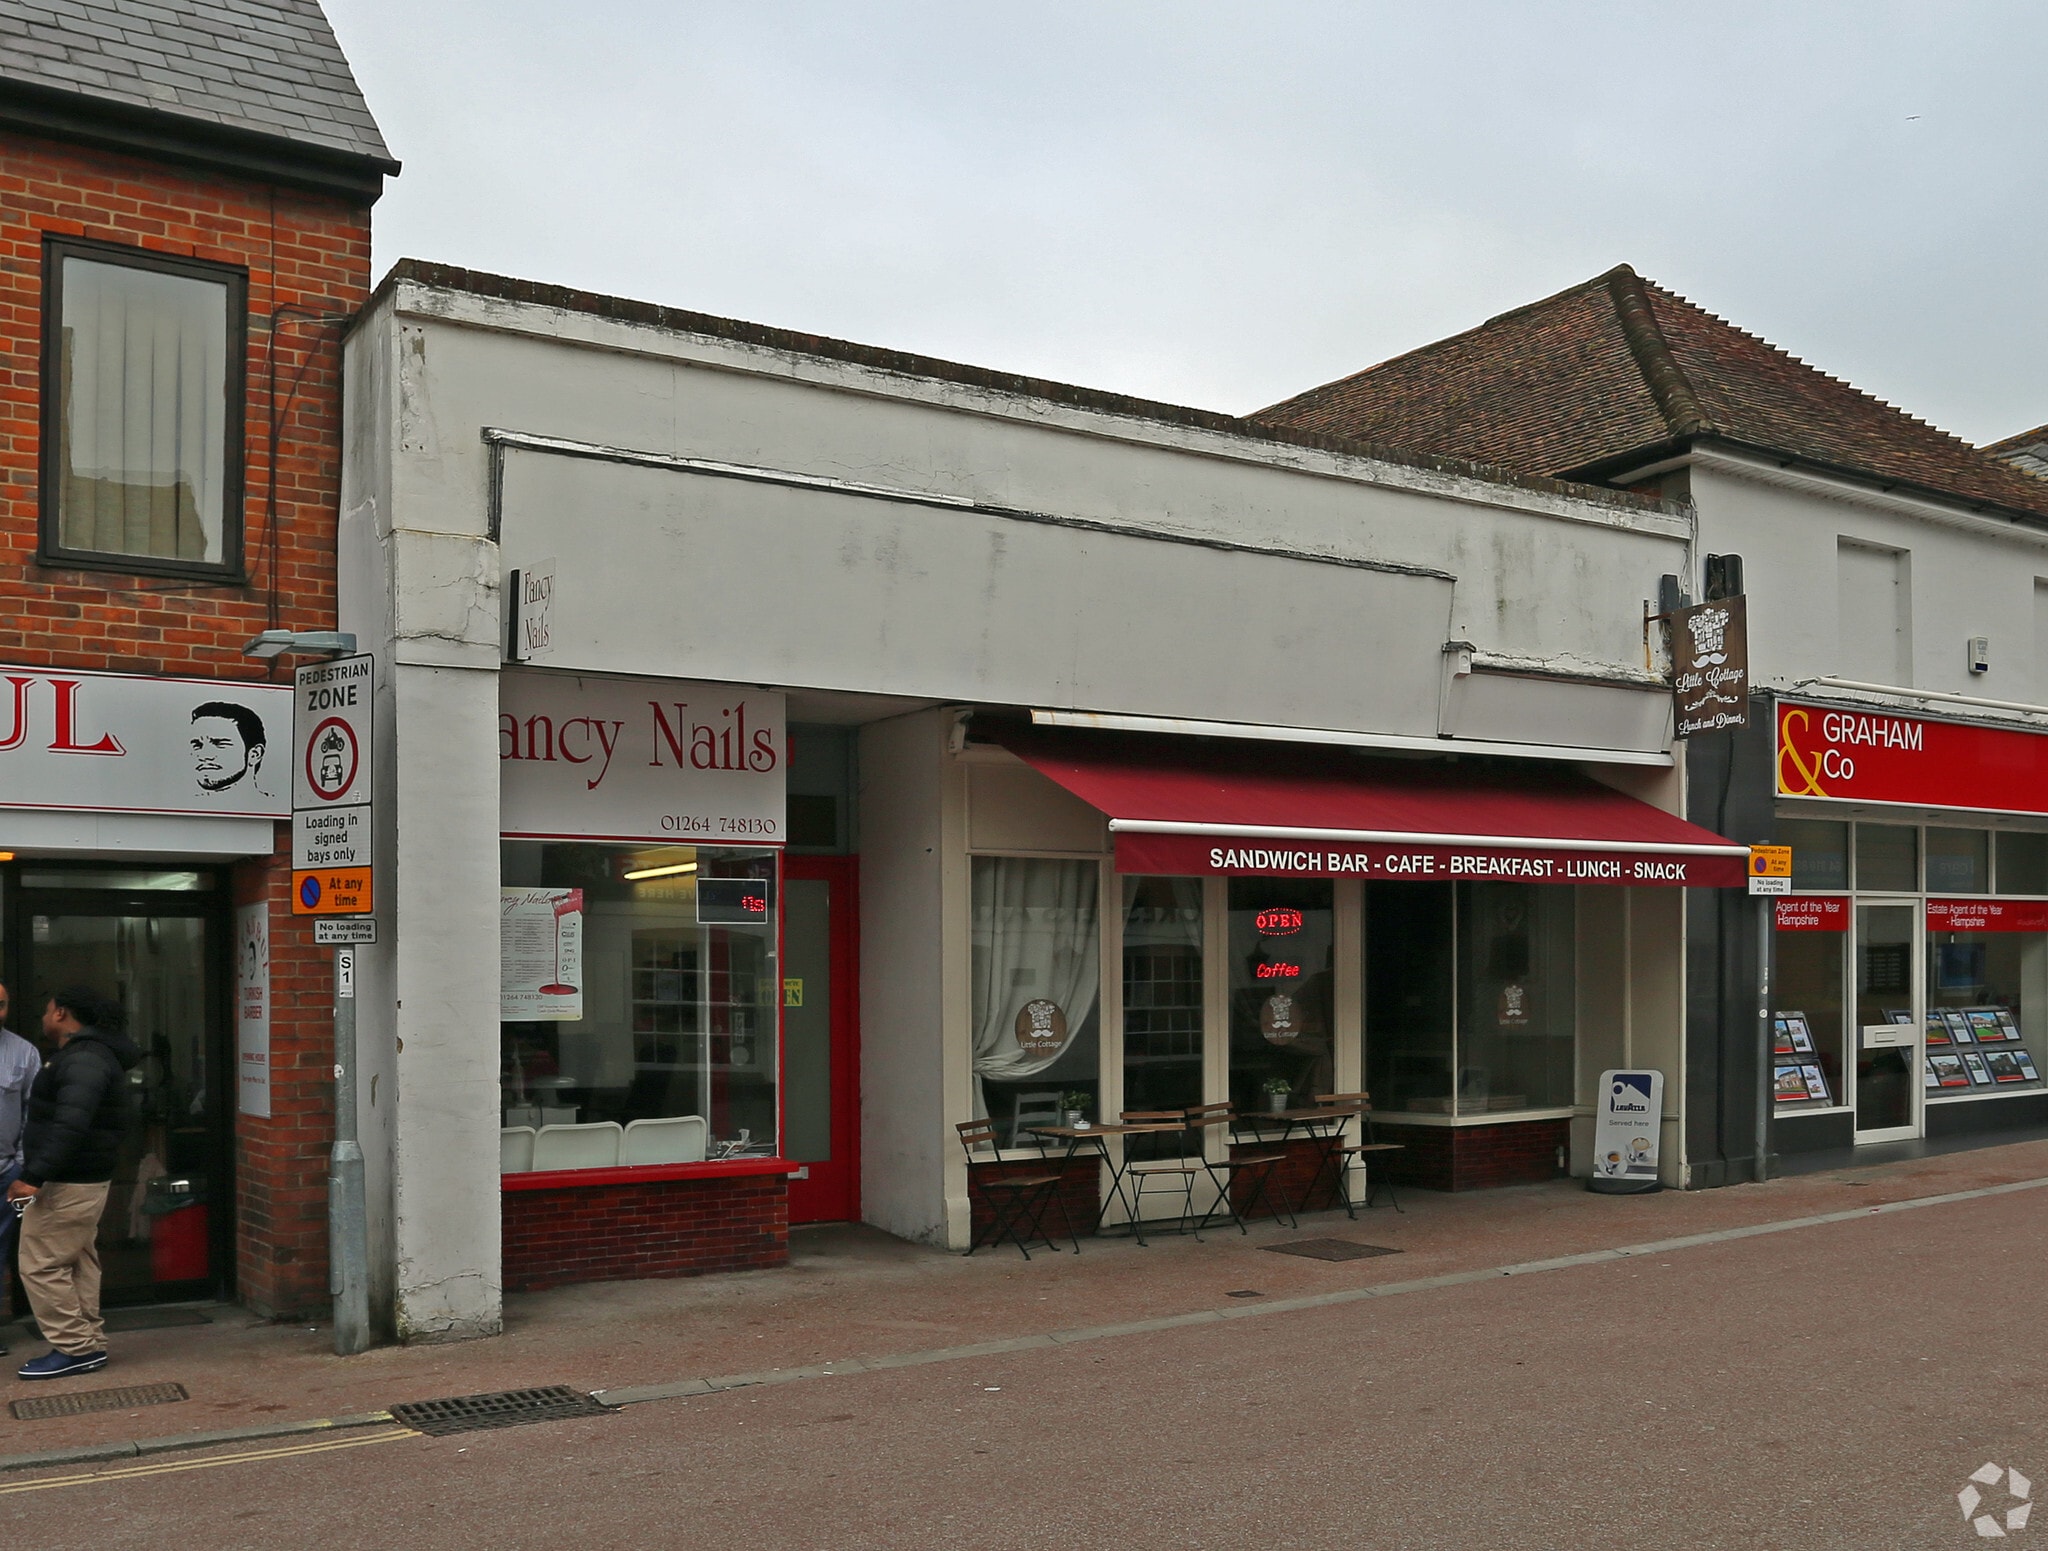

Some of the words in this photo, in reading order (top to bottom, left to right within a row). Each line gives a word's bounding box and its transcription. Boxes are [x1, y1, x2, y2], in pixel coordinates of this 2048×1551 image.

[524, 572, 553, 611] Fancy
[524, 613, 549, 651] Nails
[299, 663, 369, 686] PEDESTRIAN
[1675, 672, 1703, 693] Little
[1705, 666, 1744, 689] Cottage
[308, 685, 357, 711] ZONE
[1678, 718, 1701, 735] Lunch
[1703, 715, 1715, 728] and
[1716, 713, 1745, 729] Dinner
[1823, 712, 1923, 751] GRAHAM
[648, 701, 776, 773] Nails
[1823, 749, 1855, 779] Co
[306, 815, 344, 829] Loading
[349, 814, 357, 825] in
[660, 815, 710, 831] 01264
[719, 818, 776, 834] 748130
[315, 831, 348, 847] signed
[307, 850, 330, 863] bays
[334, 848, 355, 862] only
[1209, 848, 1321, 871] SANDWICH
[1328, 853, 1368, 872] BAR
[1385, 855, 1434, 873] CAFE
[1450, 855, 1554, 877] BREAKFAST
[1567, 860, 1621, 878] LUNCH
[1634, 861, 1686, 880] SNACK
[329, 877, 341, 890] At
[345, 879, 363, 891] any
[334, 894, 357, 907] time
[1776, 901, 1799, 915] Agent
[1800, 901, 1808, 912] of
[1810, 901, 1822, 912] the
[1824, 901, 1840, 912] Year
[1927, 903, 1948, 914] Estate
[1949, 905, 1968, 917] Agent
[1969, 905, 1976, 915] of
[1977, 905, 1988, 915] the
[1989, 905, 2003, 915] Year
[320, 923, 333, 931] No
[336, 923, 371, 933] loading
[1256, 912, 1303, 929] OPEN
[1778, 914, 1819, 928] Hampshire
[1951, 916, 1985, 928] Hampshire
[331, 934, 348, 942] any
[352, 932, 373, 940] time
[341, 956, 351, 969] S
[343, 971, 349, 983] 1
[1256, 963, 1301, 978] Coffee
[1615, 1103, 1645, 1111] LAVAZZA
